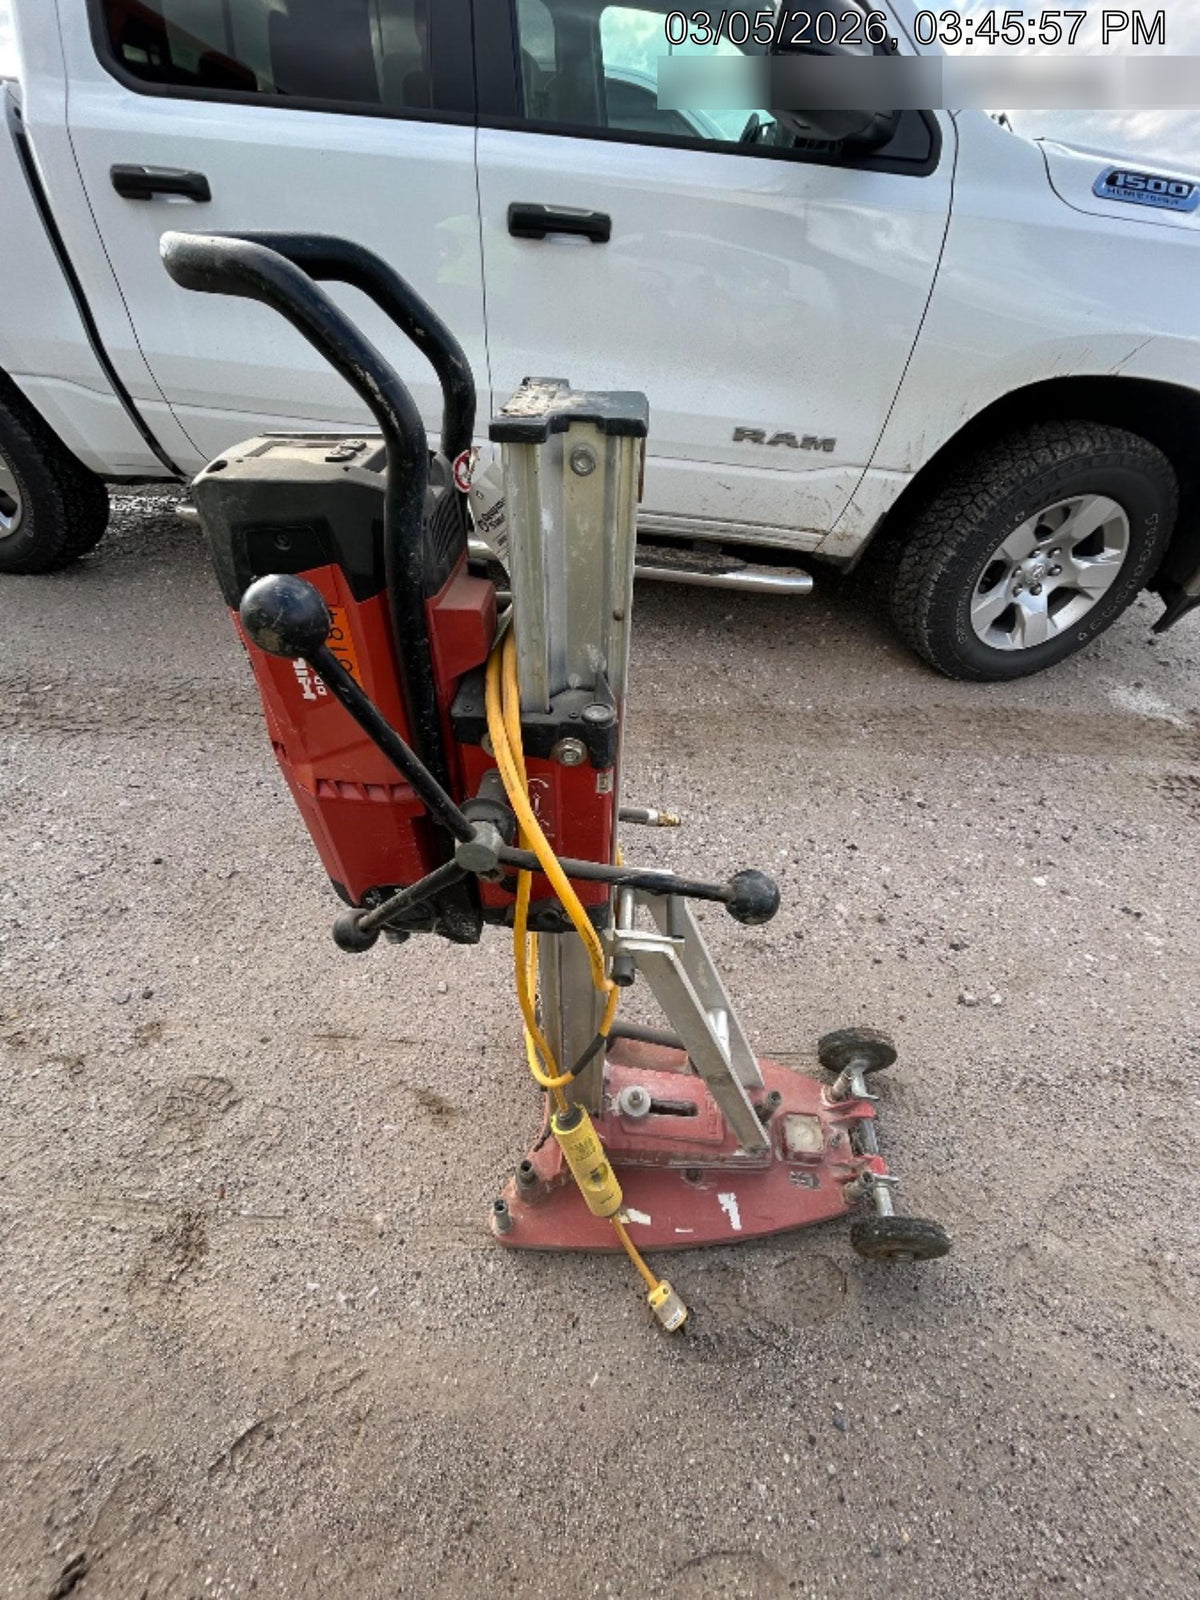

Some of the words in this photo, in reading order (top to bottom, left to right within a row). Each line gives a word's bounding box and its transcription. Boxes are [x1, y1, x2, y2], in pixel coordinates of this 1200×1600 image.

[1114, 173, 1189, 197] 1500
[732, 426, 838, 452] RAM
[292, 657, 317, 700] HIL
